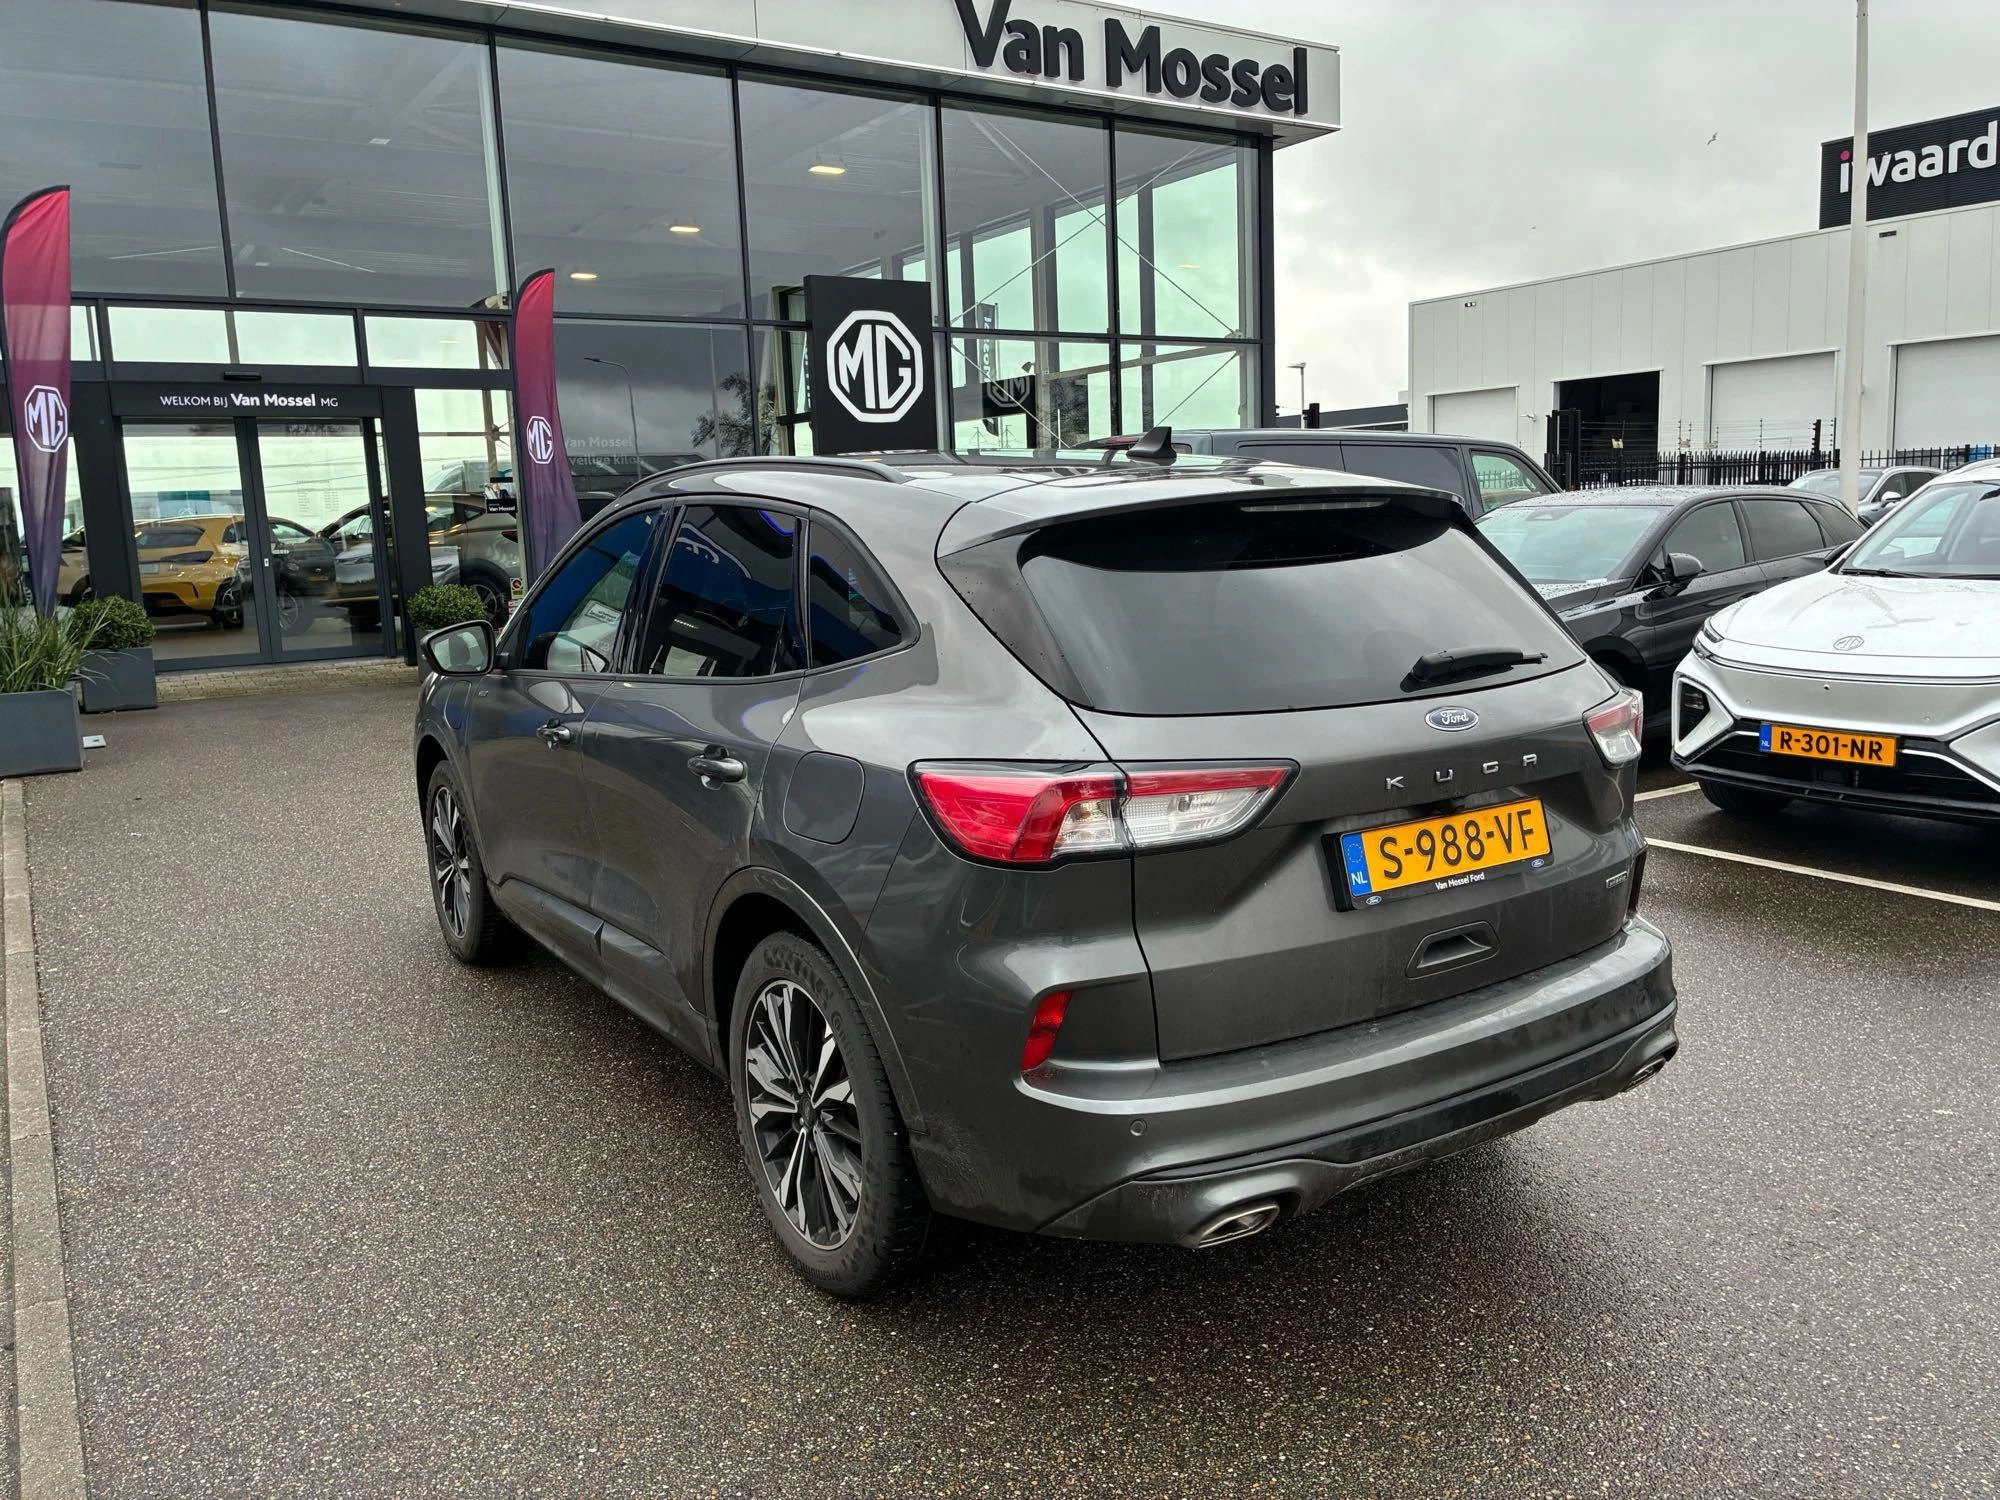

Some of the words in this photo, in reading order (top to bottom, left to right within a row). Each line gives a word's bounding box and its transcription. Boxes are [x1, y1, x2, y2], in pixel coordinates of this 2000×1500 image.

[955, 0, 1085, 82] Van
[1104, 17, 1309, 116] Mossel
[836, 322, 914, 410] MG
[160, 396, 211, 406] WELKOM
[214, 396, 228, 408] BIJ
[230, 393, 260, 407] Van
[263, 393, 316, 407] Mossel
[320, 398, 338, 407] MG
[27, 391, 64, 447] MG
[528, 420, 553, 460] MG
[588, 436, 632, 447] Mossel
[1438, 710, 1470, 725] Ford
[1761, 739, 1770, 748] NL
[1779, 731, 1883, 761] R-301-NR
[1385, 753, 1538, 790] KUGA
[1379, 809, 1534, 879] S-988-VF
[1351, 872, 1368, 885] NL
[1435, 880, 1447, 890] Van
[1448, 876, 1469, 888] Mossel
[1470, 872, 1485, 882] Ford
